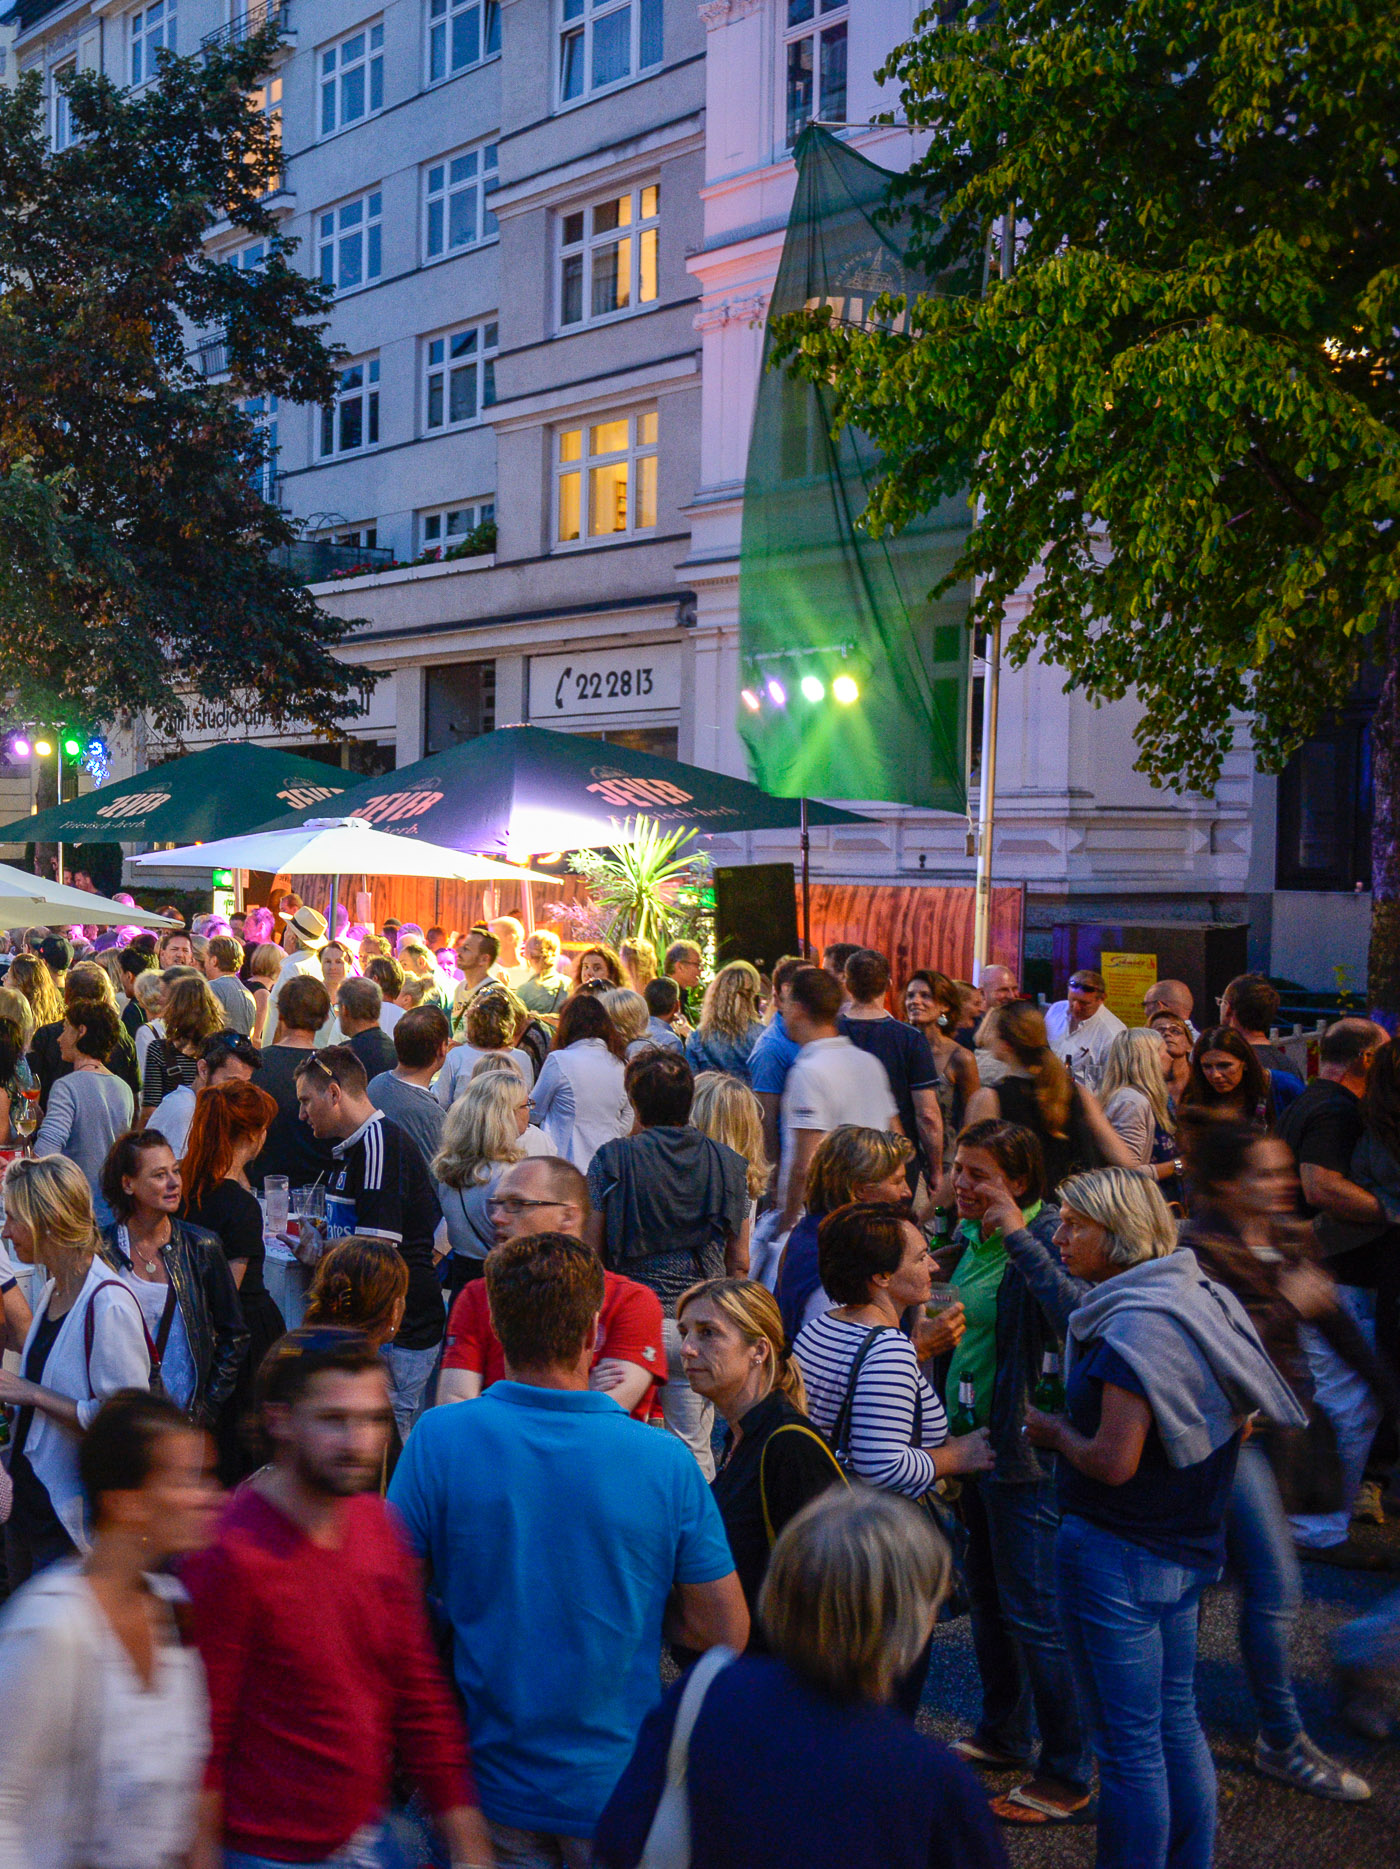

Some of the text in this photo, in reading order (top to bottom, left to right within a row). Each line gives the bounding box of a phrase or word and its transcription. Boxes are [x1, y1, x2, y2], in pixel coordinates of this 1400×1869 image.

[96, 793, 172, 818] JEVER
[349, 791, 445, 823] JEVER
[586, 777, 694, 807] JEVER
